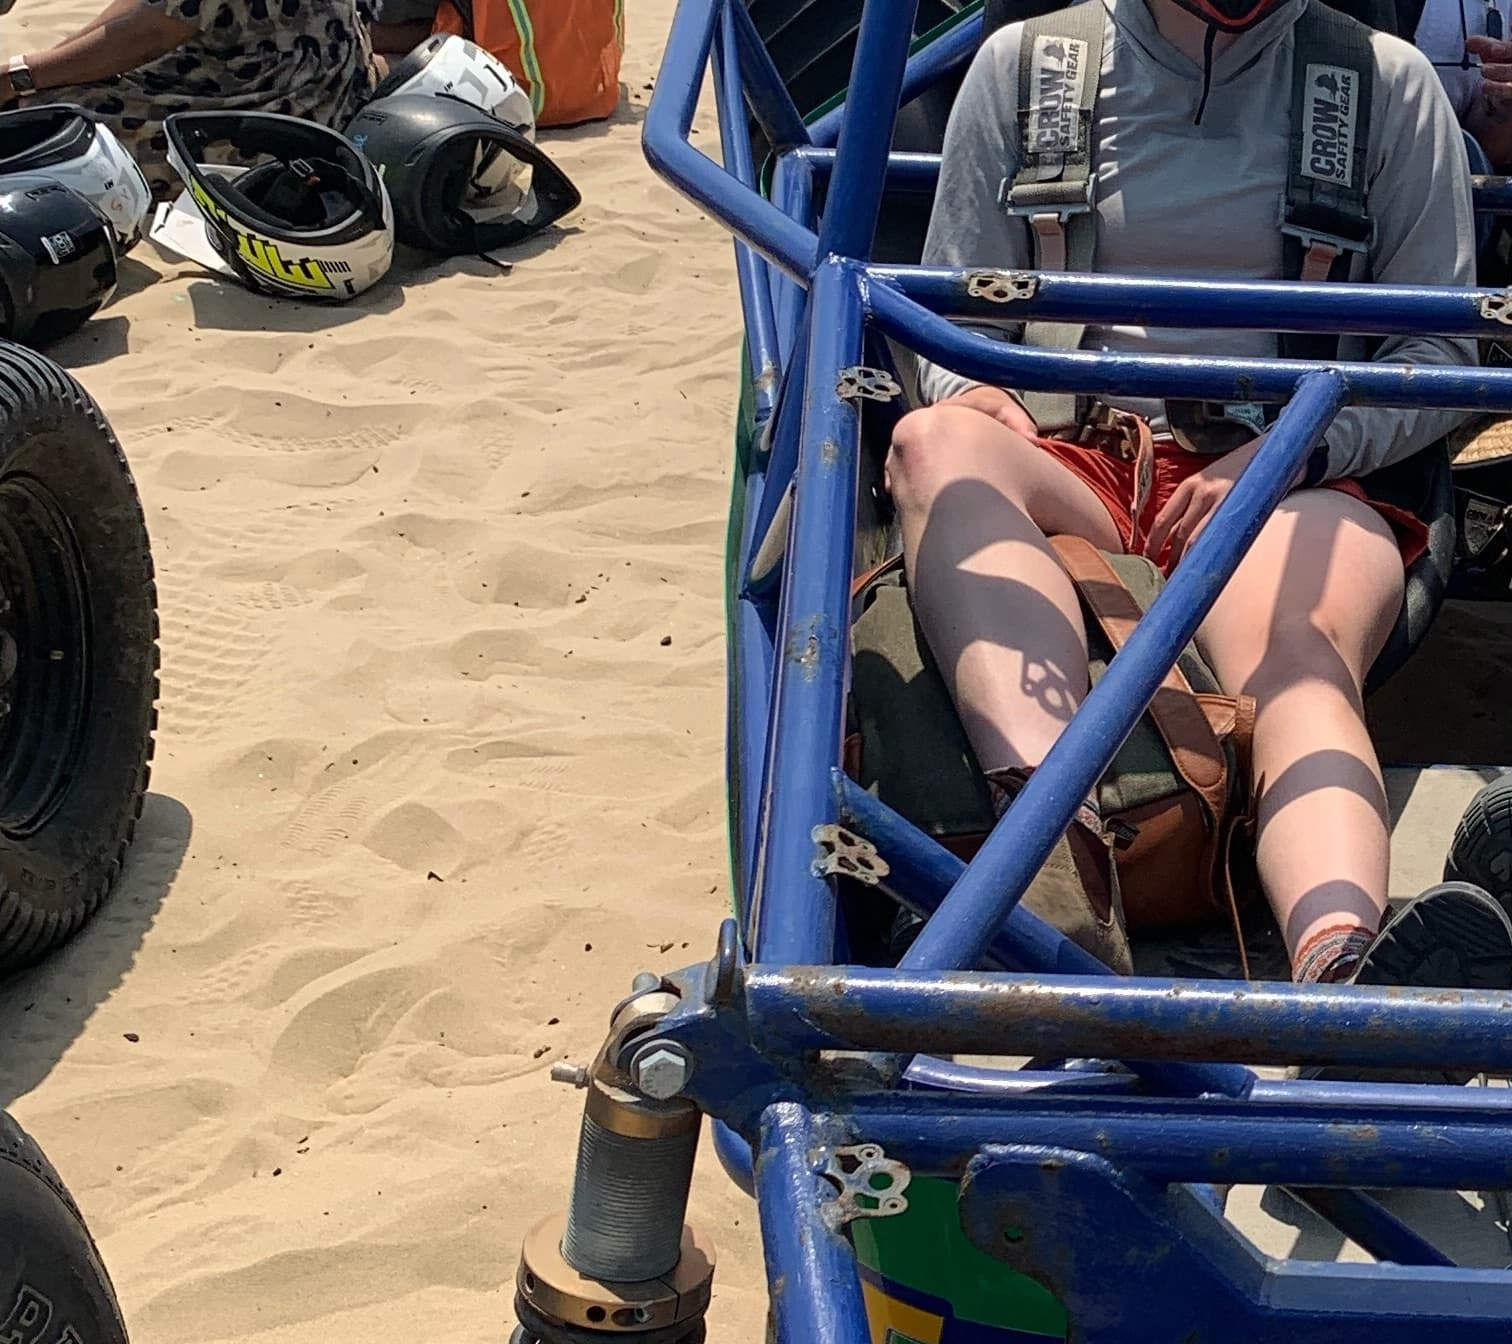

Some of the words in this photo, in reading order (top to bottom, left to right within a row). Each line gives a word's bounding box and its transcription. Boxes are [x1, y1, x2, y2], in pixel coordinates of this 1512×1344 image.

[1065, 43, 1082, 82] GEAR
[1338, 75, 1352, 114] GEAR
[1037, 68, 1065, 151] CROW
[1060, 84, 1078, 150] SAFETY
[1311, 97, 1338, 177] CROW
[1335, 115, 1350, 181] SAFETY
